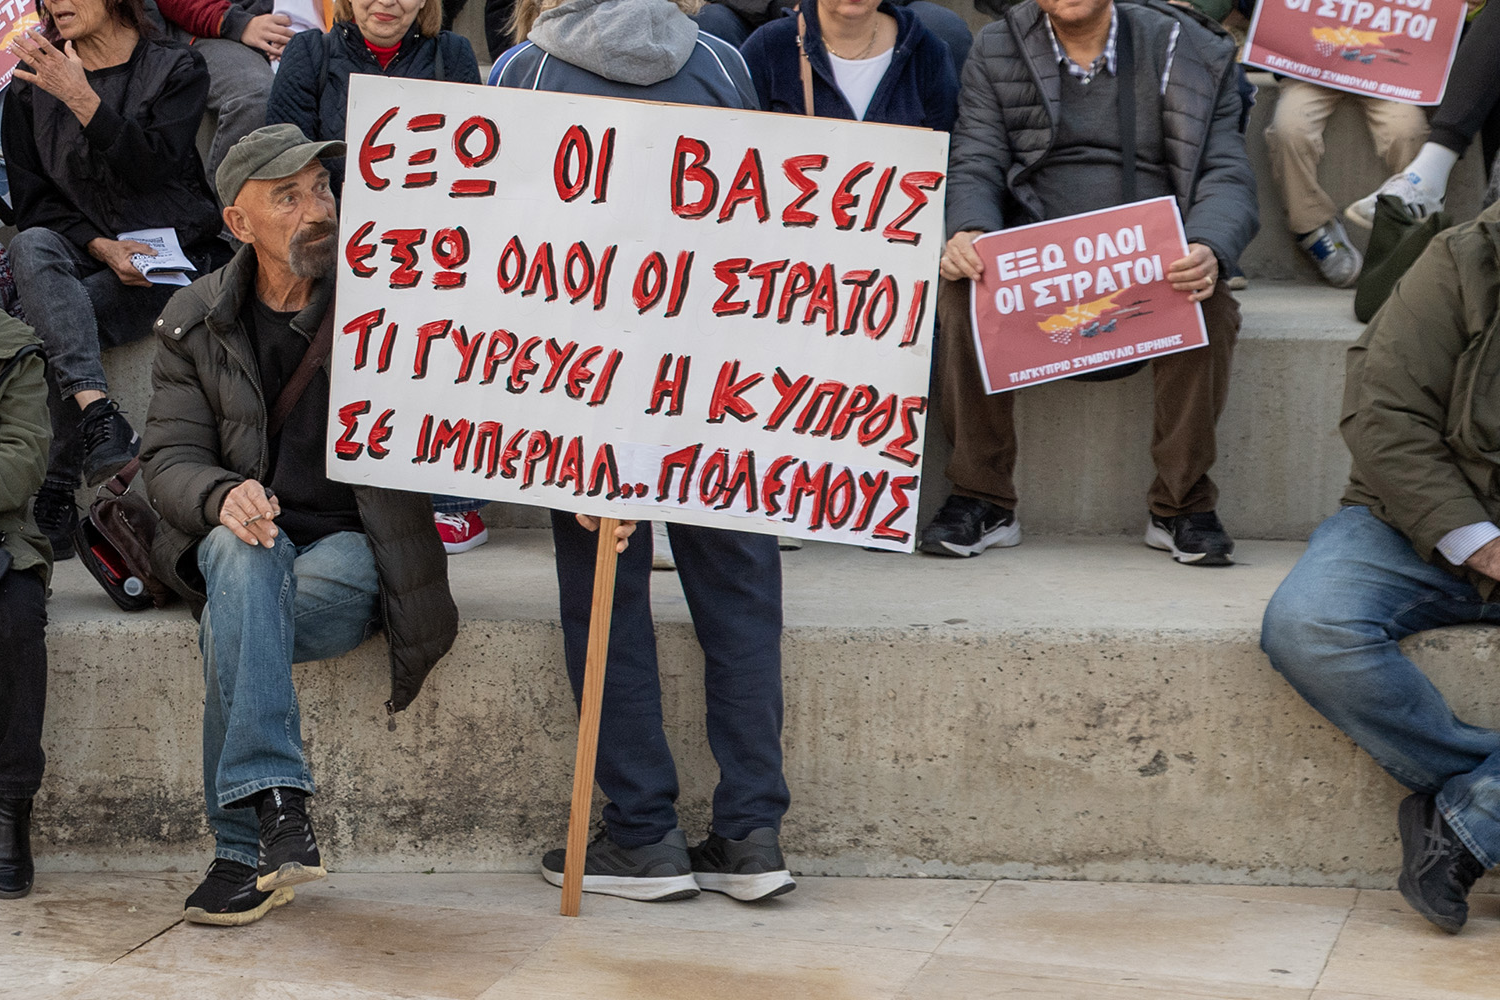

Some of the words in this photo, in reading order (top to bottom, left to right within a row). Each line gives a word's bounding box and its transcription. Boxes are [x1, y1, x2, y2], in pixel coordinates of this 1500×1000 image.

[1265, 54, 1321, 77] ΠΑΓΚΥΠΡΙΟ
[1321, 70, 1378, 90] ΣΥΜΒΟΥΛΙΟ
[1378, 83, 1422, 99] ΕΙΡΗΝΗΣ
[359, 105, 501, 198] ΕΞΩ
[554, 125, 616, 204] ΟΙ
[670, 134, 945, 246] ΒΑΣΕΙΣ
[345, 221, 470, 290] ΕΞΩ
[497, 235, 618, 310] ΟΛΟΙ
[632, 250, 695, 317] ΟΙ
[711, 257, 929, 348] ΣΤΡΑΤΟΙ
[995, 284, 1025, 315] ΟΙ
[1030, 254, 1164, 308] ΣΤΡΑΤΟΙ
[997, 243, 1067, 281] ΕΞΩ
[1074, 225, 1147, 264] ΟΛΟΙ
[342, 308, 398, 373] ΤΙ
[412, 319, 623, 407] ΓΥΡΕΥΕΙ
[646, 353, 690, 416] Η
[707, 360, 927, 467] ΚΥΠΡΟΣ
[1009, 360, 1071, 383] ΠΑΓΚΥΠΡΙΟ
[1072, 347, 1134, 368] ΣΥΜΒΟΥΛΙΟ
[1136, 334, 1184, 354] ΕΙΡΗΝΗΣ
[335, 400, 394, 461] ΣΕ
[656, 443, 919, 543] ΠΟΛΕΜΟΥΣ
